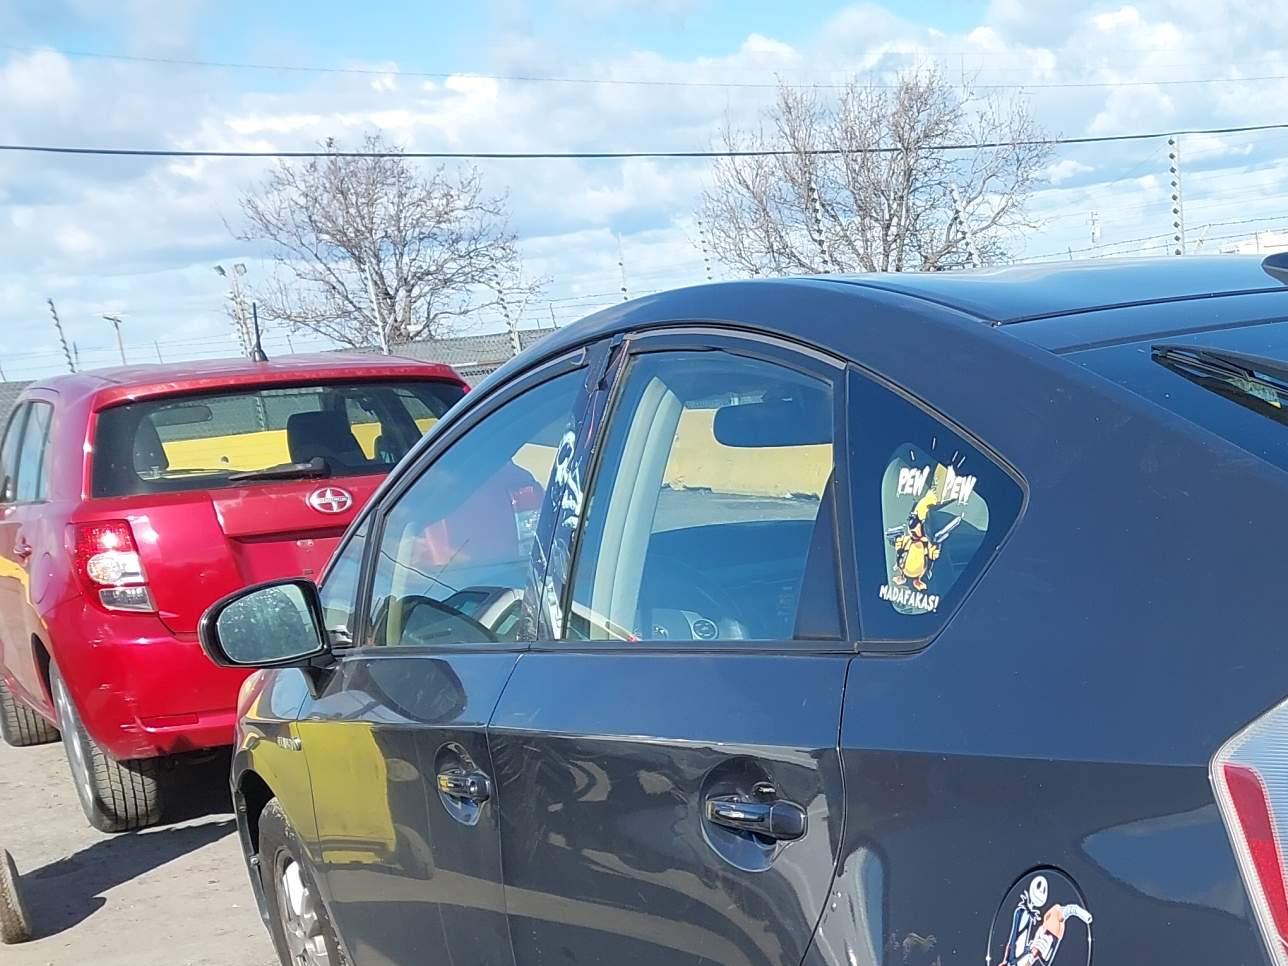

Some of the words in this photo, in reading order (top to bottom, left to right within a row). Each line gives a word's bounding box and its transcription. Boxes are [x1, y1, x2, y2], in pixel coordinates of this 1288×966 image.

[897, 465, 930, 497] PEW
[941, 465, 977, 505] PEW
[879, 584, 940, 613] MADAFAKAS!
